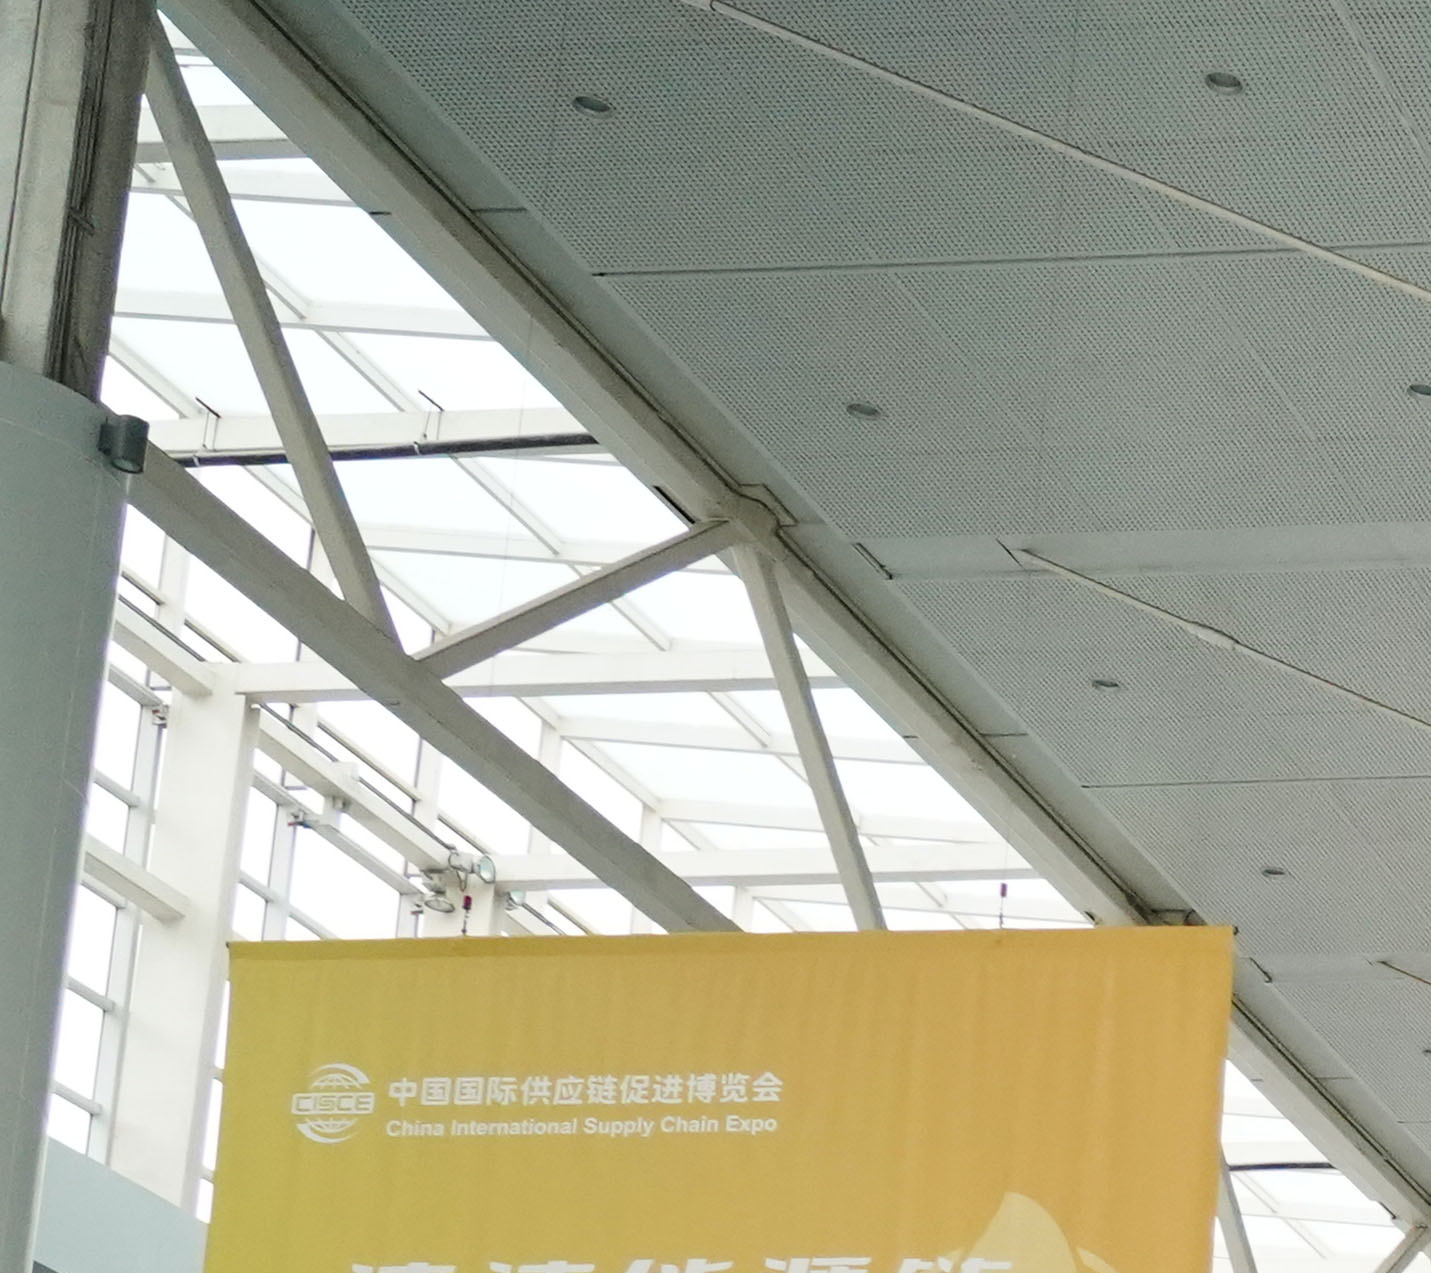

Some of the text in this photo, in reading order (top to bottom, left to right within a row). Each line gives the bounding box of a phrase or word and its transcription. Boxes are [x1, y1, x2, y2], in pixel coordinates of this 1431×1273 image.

[389, 1072, 783, 1106] 中国国际供应链促进博览会
[386, 1115, 777, 1137] China International Supply Chain Expo
